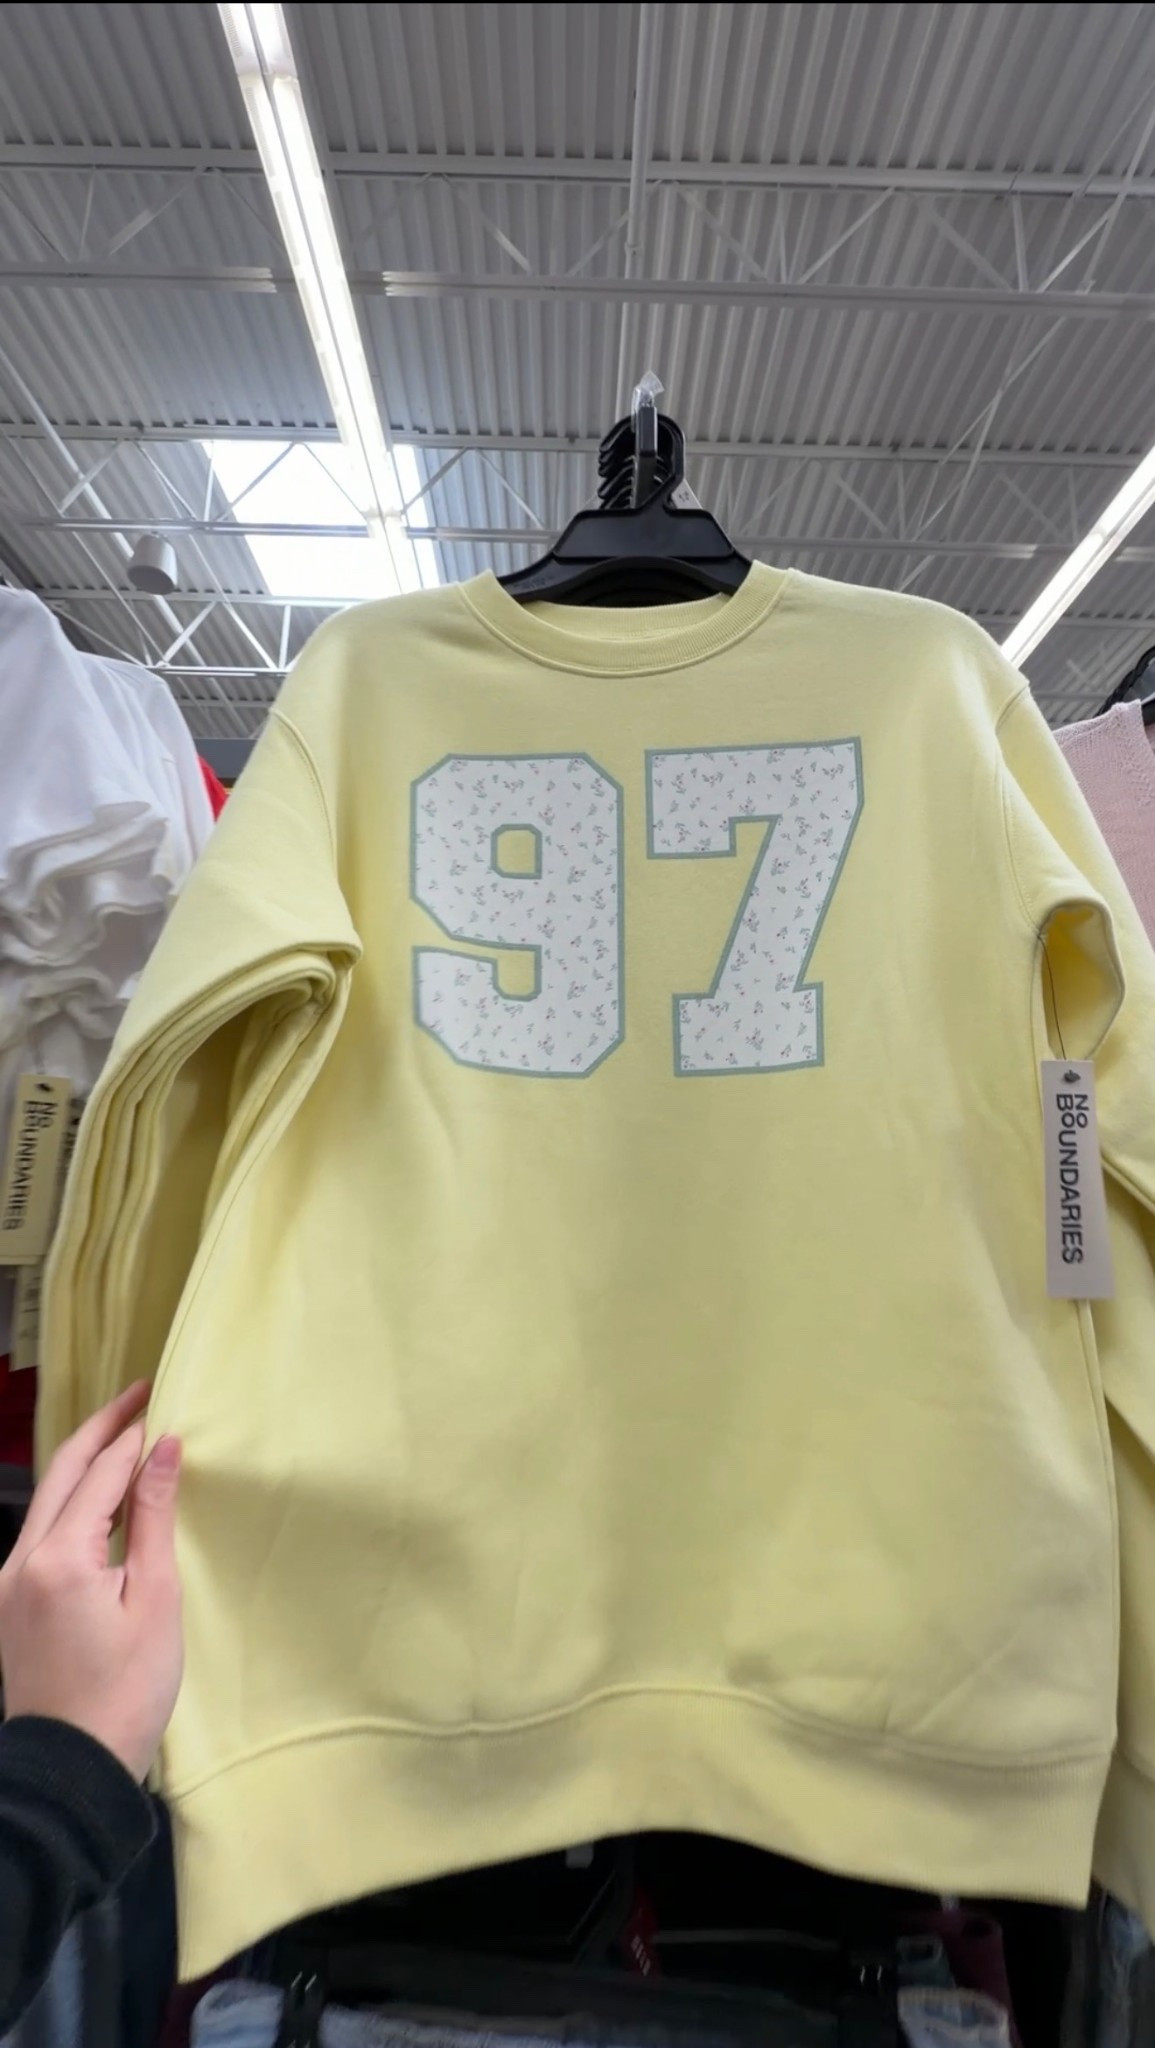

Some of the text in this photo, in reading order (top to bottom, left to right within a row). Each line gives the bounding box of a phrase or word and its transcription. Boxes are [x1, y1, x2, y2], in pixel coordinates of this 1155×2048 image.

[410, 737, 865, 1079] 97
[1056, 1093, 1084, 1265] BOUNDARIES
[1073, 1093, 1089, 1129] NO
